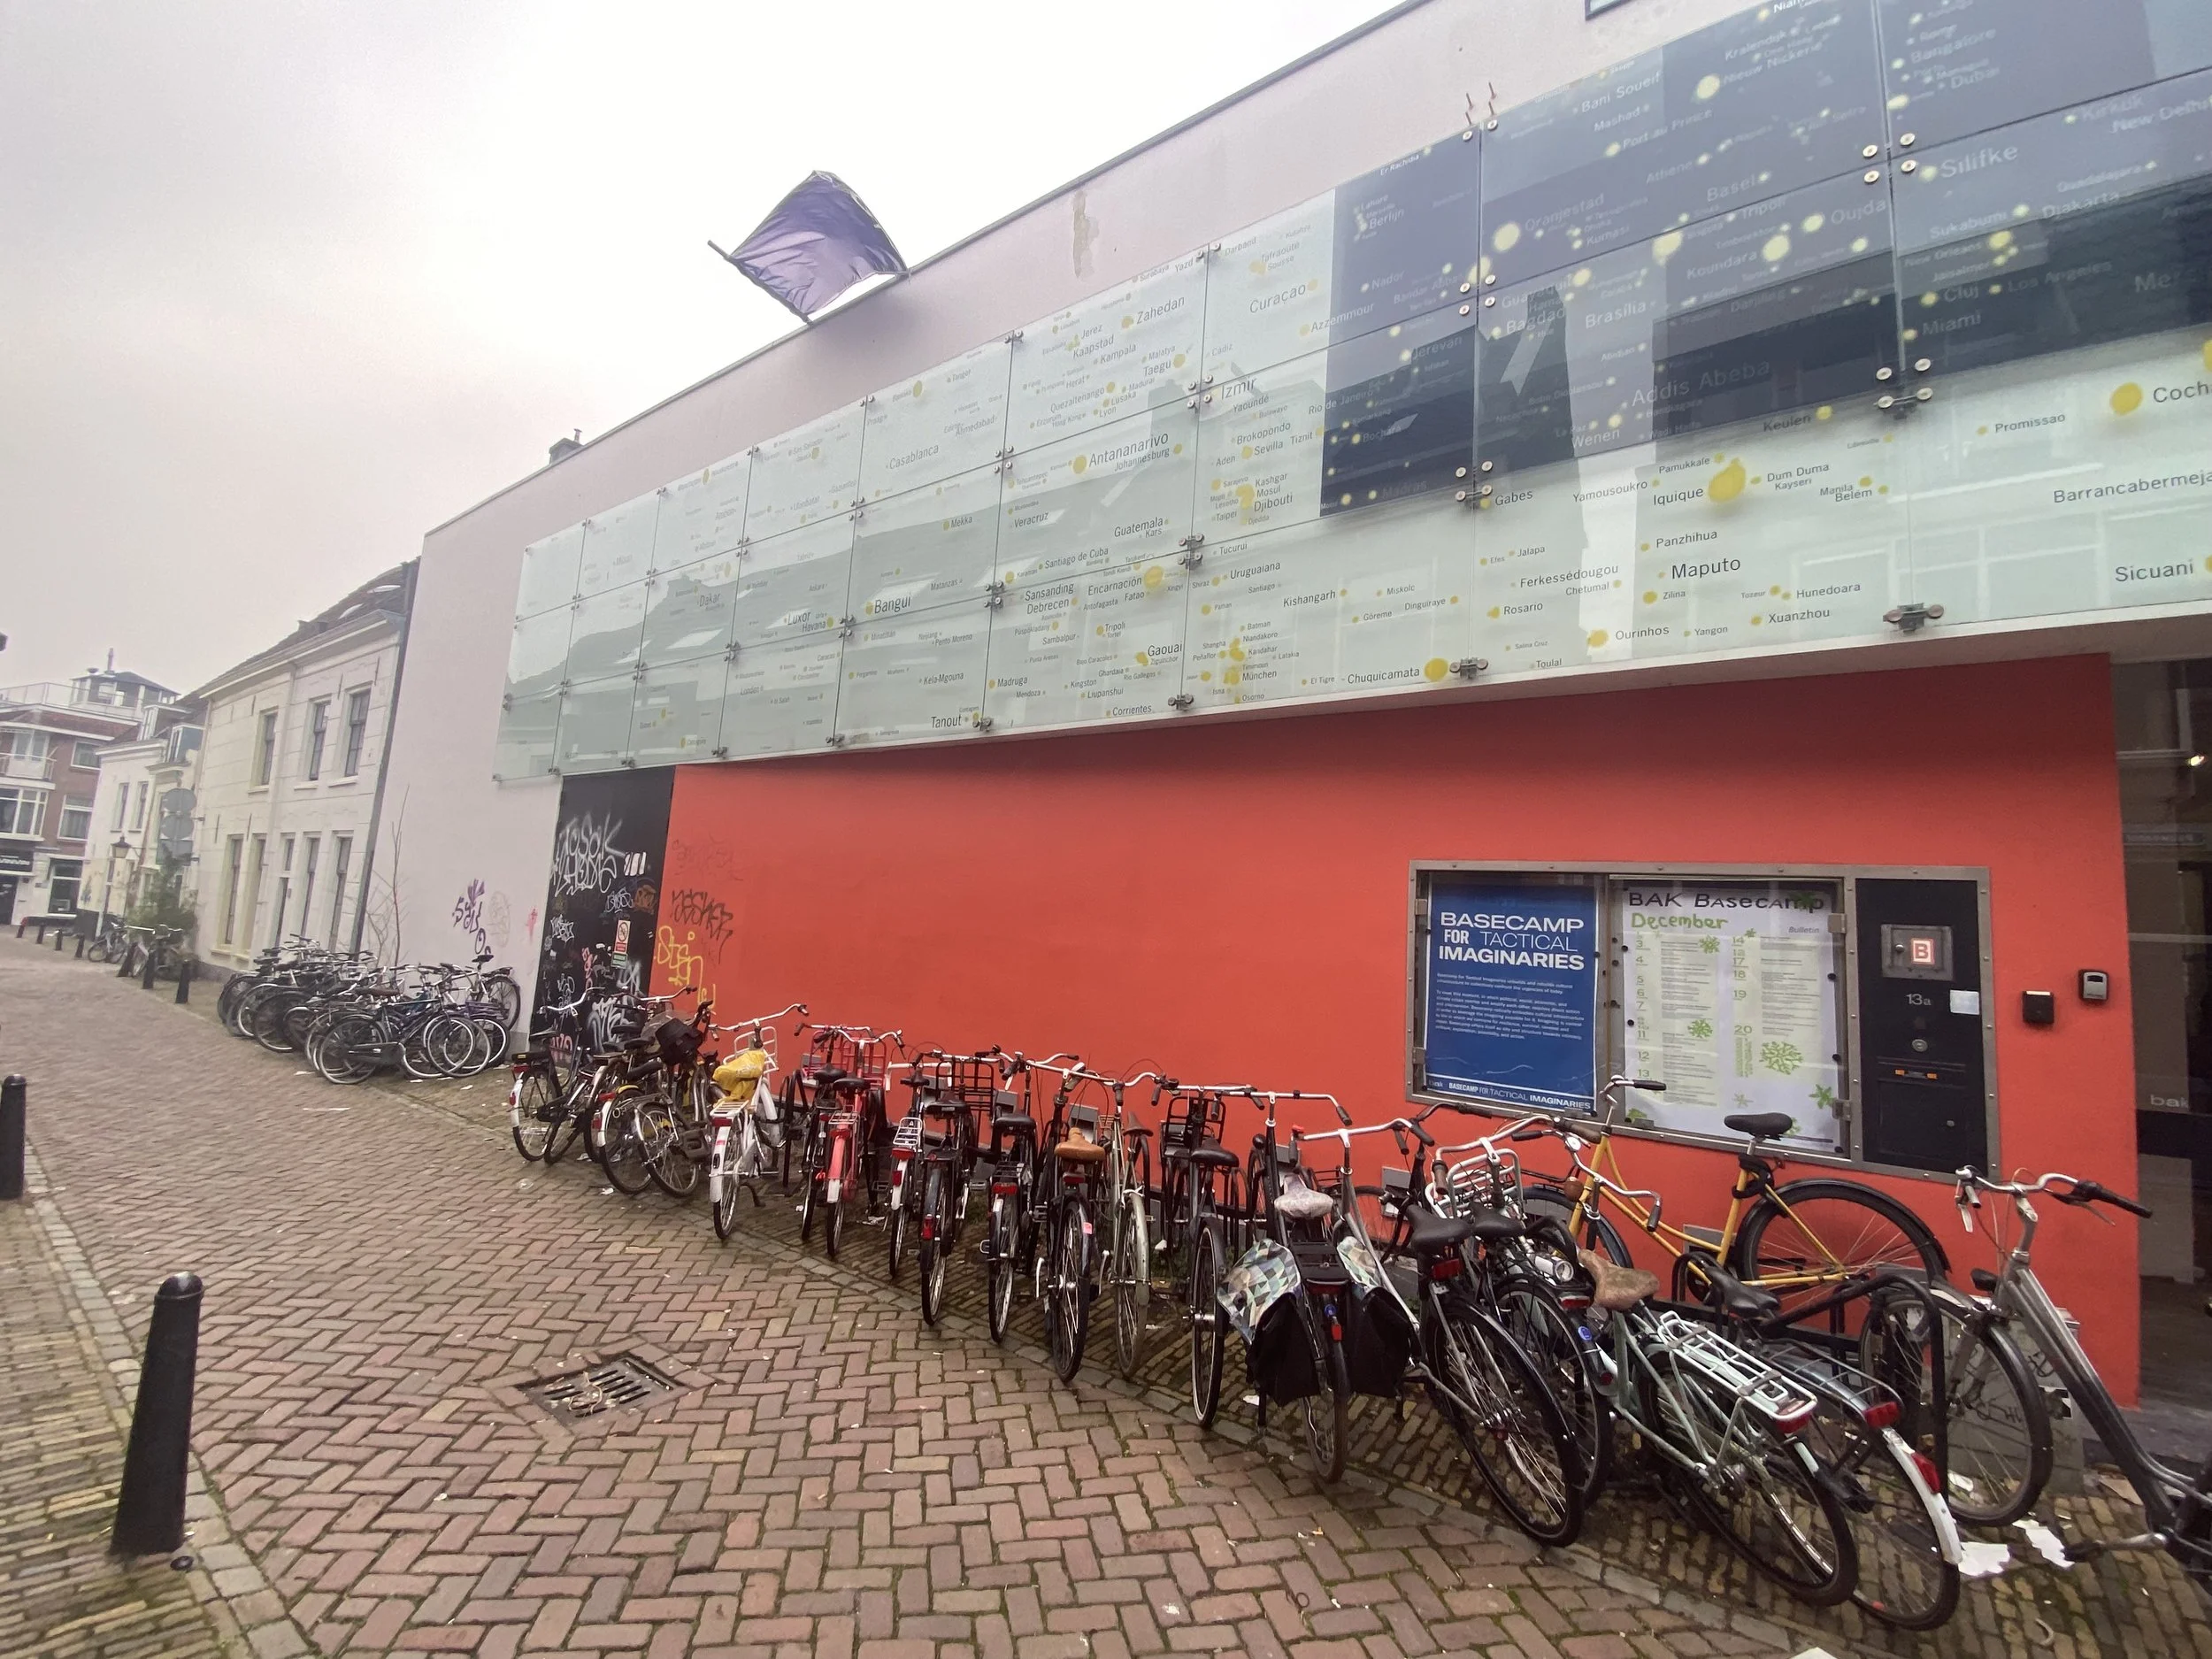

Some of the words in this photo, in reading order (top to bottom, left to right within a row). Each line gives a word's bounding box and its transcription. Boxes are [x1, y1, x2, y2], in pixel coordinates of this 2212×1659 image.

[1910, 27, 1996, 63] Bangalore
[1722, 65, 1763, 86] Nieuw
[1580, 96, 1611, 113] Bani
[1593, 106, 1641, 133] Mashad
[1622, 133, 1649, 150] Port
[1651, 127, 1669, 140] au
[1671, 108, 1715, 134] Prince
[2111, 112, 2154, 134] New
[1939, 142, 2020, 179] Silifke
[1646, 160, 1693, 185] Athene
[1706, 173, 1757, 203] Basel
[1525, 194, 1606, 232] Oranjestad
[1829, 198, 1889, 226] Oujda
[2039, 189, 2120, 219] Djakarta
[1369, 209, 1406, 230] Berlijn
[1929, 209, 2008, 240] Sukabumi
[1173, 257, 1194, 273] Yazd
[1686, 251, 1757, 281] Koundara
[1371, 270, 1406, 291] Nador
[2007, 280, 2039, 296] Los
[2044, 260, 2114, 286] Angeles
[1248, 283, 1307, 315] Curaçao
[1942, 286, 1981, 310] Cluj
[1135, 296, 1186, 325] Zahedan
[1310, 303, 1375, 334] Azzemmour
[1584, 301, 1647, 331] Brasília
[1921, 311, 1983, 336] Miami
[1072, 333, 1116, 360] Kaapstad
[1100, 342, 1137, 365] Kampala
[1142, 358, 1172, 378] Taegu
[1632, 380, 1691, 409] Addis
[1698, 359, 1771, 391] Abeba
[2153, 378, 2212, 404] Coch
[1110, 391, 1138, 408] Lusaka
[1233, 396, 1270, 415] Yaoundé
[1098, 405, 1118, 422] Lyon
[1763, 414, 1812, 433] Keulen
[1236, 421, 1292, 447] Brokopondo
[1572, 428, 1621, 449] Wenen
[888, 444, 940, 470] Casablanca
[1087, 433, 1170, 468] Antananarivo
[1254, 441, 1284, 457] Sevilla
[1114, 447, 1171, 472] Johannesburg
[1215, 455, 1236, 468] Aden
[1658, 456, 1711, 475] Pamukkale
[1255, 472, 1289, 489] Kashgar
[1766, 470, 1793, 483] Dum
[1795, 463, 1831, 478] Duma
[1256, 484, 1282, 500] Mosul
[1572, 480, 1648, 504] Yamousoukro
[1819, 483, 1855, 497] Manila
[1834, 487, 1874, 503] Belém
[2053, 467, 2212, 503] Barrancabermeja
[1254, 492, 1294, 515] Djibouti
[1494, 489, 1534, 510] Gabes
[1652, 488, 1705, 508] Iquique
[949, 514, 973, 529] Mekka
[1013, 511, 1049, 531] Veracruz
[1113, 516, 1164, 541] Guatemala
[1145, 529, 1163, 540] Kars
[1655, 531, 1718, 549] Panzhihua
[1044, 556, 1077, 571] Santiago
[1078, 551, 1088, 562] de
[1089, 546, 1110, 558] Cuba
[1517, 544, 1547, 559] Jalapa
[1229, 561, 1281, 581] Uruguaiana
[1519, 565, 1620, 590] Ferkessédougou
[1671, 557, 1742, 581] Maputo
[2115, 558, 2194, 583] Sicuani
[1024, 582, 1075, 603] Sansanding
[1087, 576, 1142, 598] Encarnación
[1386, 583, 1416, 597] Miskolc
[1564, 581, 1610, 597] Chetumal
[1663, 590, 1686, 602] Zilina
[1796, 582, 1862, 600] Hunedoara
[699, 591, 721, 607] Dakar
[873, 595, 912, 616] Bangui
[1026, 597, 1071, 617] Debrecen
[1282, 590, 1337, 609] Kishangarh
[1403, 598, 1448, 612] Dinguiraye
[787, 611, 812, 626] Luxor
[1503, 602, 1544, 618] Rosario
[1768, 608, 1831, 625] Xuanzhou
[1103, 620, 1127, 635] Tripoli
[1245, 619, 1271, 632] Batman
[1614, 625, 1671, 641] Ourinhos
[1694, 625, 1729, 639] Yangon
[996, 676, 1029, 689] Madruga
[1070, 679, 1098, 691] Kingston
[1240, 671, 1279, 685] München
[1347, 666, 1421, 687] Chuquicamata
[1241, 692, 1266, 703] Osorno
[1111, 703, 1153, 718] Corrientes
[930, 713, 964, 729] Tanout
[1628, 891, 1682, 908] BAK
[1440, 912, 1585, 934] BASECAMP
[1631, 912, 1729, 930] December
[1787, 926, 1820, 934] Bulletin
[1443, 929, 1470, 945] FOR
[1480, 930, 1579, 953] TACTICAL
[1636, 940, 1644, 949] 3
[1438, 945, 1586, 972] IMAGINARIES
[1635, 956, 1644, 964] 4
[1636, 1001, 1645, 1010] 7
[1906, 992, 1932, 1007] 13a
[1734, 1025, 1753, 1034] 20
[1637, 1050, 1650, 1061] 12
[1637, 1068, 1650, 1079] 13
[1448, 1082, 1479, 1094] BASECAMP
[1489, 1087, 1529, 1102] TACTICAL
[1529, 1094, 1592, 1110] IMAGINARIES
[2150, 1094, 2189, 1109] bak
